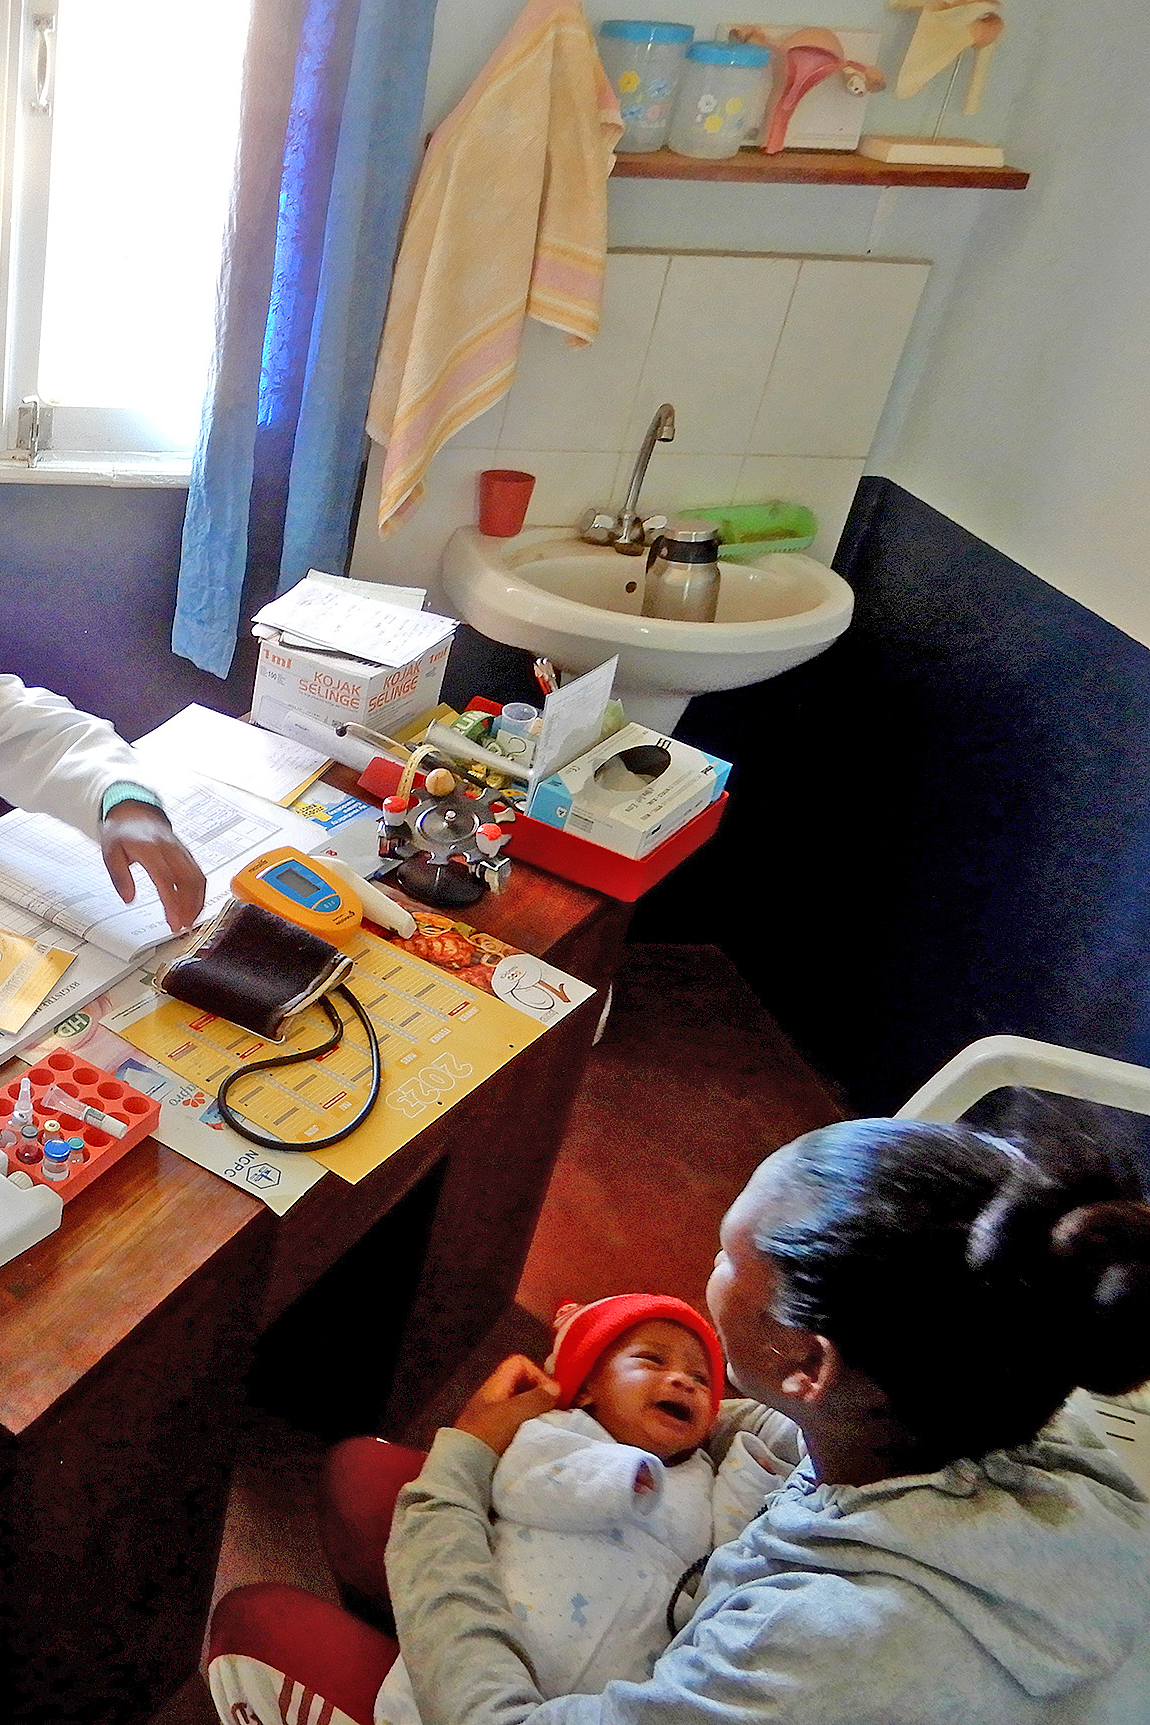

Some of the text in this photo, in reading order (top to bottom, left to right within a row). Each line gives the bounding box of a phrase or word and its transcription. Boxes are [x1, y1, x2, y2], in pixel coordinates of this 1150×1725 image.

[313, 671, 362, 697] KOJAK
[383, 659, 423, 690] KOJAK
[299, 679, 361, 711] SELINGE
[367, 675, 418, 713] SELINGE
[57, 1012, 89, 1038] HD
[385, 1052, 474, 1119] 2023
[224, 1149, 261, 1179] NCPC
